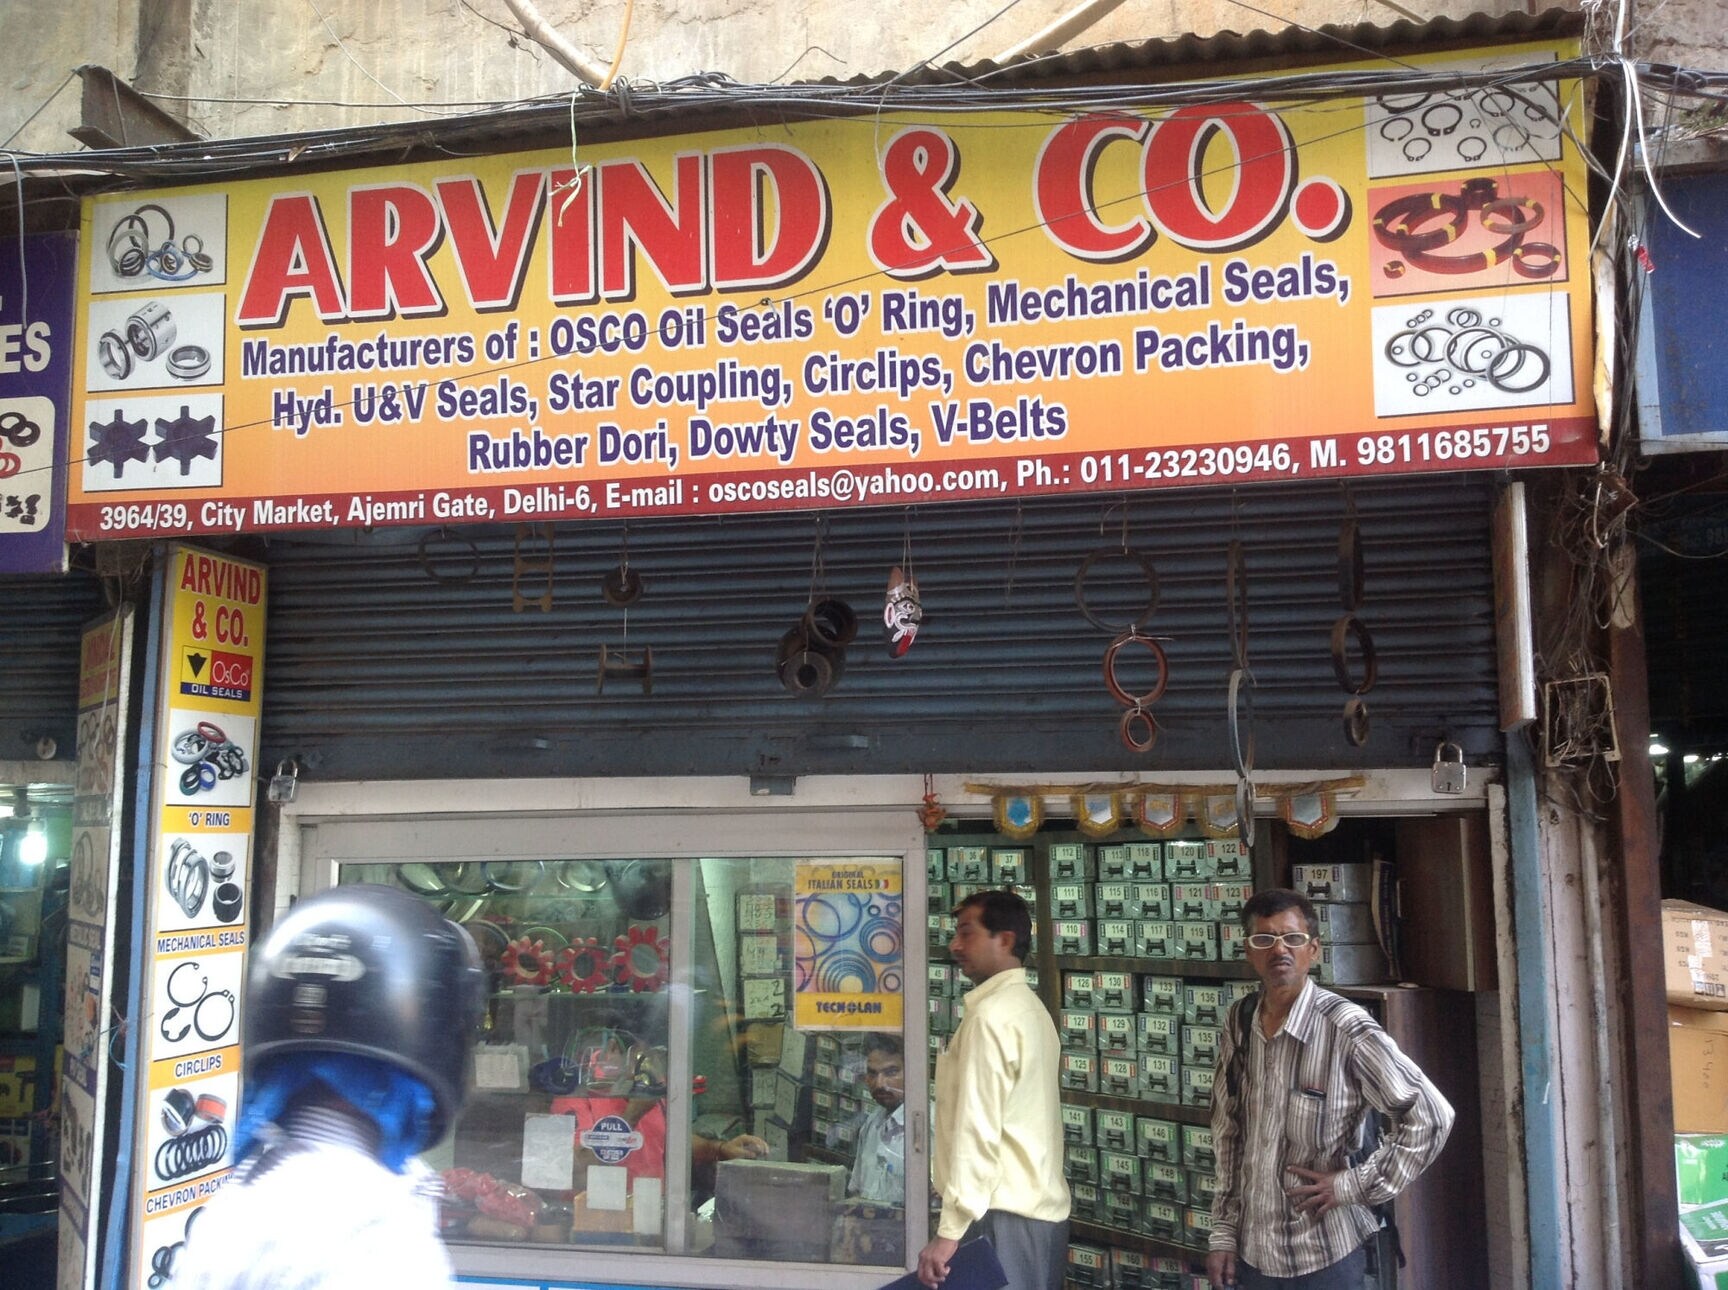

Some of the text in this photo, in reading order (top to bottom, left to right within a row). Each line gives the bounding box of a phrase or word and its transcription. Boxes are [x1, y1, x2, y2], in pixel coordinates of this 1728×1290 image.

[234, 100, 1350, 327] ARVIND & CO.
[243, 334, 474, 376] Manufacturers
[485, 322, 518, 361] of
[550, 313, 647, 357] OSCO
[659, 308, 705, 348] Oil
[717, 300, 813, 343] Seals
[883, 291, 974, 337] Ring,
[988, 265, 1209, 323] Mechanical
[1224, 255, 1349, 302] Seals,
[274, 322, 1308, 435] Hyd. U&V Seals, Star Coupling, Circlips, Chevron Packing,
[469, 399, 1066, 470] Rubber Dori, Dowty Seals, V-Belts
[99, 503, 194, 531] 3964/39,
[200, 501, 246, 532] City
[253, 491, 340, 526] Market,
[347, 488, 426, 523] Ajemri
[432, 484, 496, 520] Gate,
[504, 483, 598, 515] Delhi-6,
[606, 478, 683, 509] E-mail
[708, 466, 1008, 503] oscoseals@yahoo.com,
[1016, 451, 1070, 487] Ph.:
[1080, 445, 1300, 482] 011-23230946,
[1309, 438, 1347, 469] M.
[1356, 423, 1550, 466] 9811685755
[181, 553, 261, 605] ARVIND
[191, 600, 248, 647] & CO.
[191, 683, 243, 699] OIL SEALS
[205, 811, 230, 827] RING
[1222, 843, 1236, 853] 122
[1005, 855, 1013, 864] 37
[1311, 868, 1328, 880] 197
[807, 879, 873, 890] ITALIAN SEALS
[1188, 887, 1201, 897] 121
[1226, 887, 1240, 897] 123
[1066, 924, 1078, 934] 110
[1111, 924, 1124, 934] 114
[1151, 924, 1163, 934] 117
[1190, 926, 1204, 937] 119
[156, 929, 246, 953] MECHANICAL SEALS
[1109, 976, 1122, 986] 130
[1159, 981, 1173, 992] 133
[1073, 1016, 1086, 1026] 127
[1112, 1018, 1126, 1029] 129
[1152, 1020, 1167, 1031] 132
[1198, 1032, 1213, 1043] 135
[174, 1054, 222, 1078] CIRCLIPS
[1074, 1059, 1087, 1069] 125
[1152, 1059, 1167, 1070] 131
[1069, 1111, 1081, 1121] 141
[1110, 1116, 1123, 1127] 143
[600, 1122, 623, 1132] PULL
[1152, 1126, 1166, 1138] 146
[1116, 1159, 1129, 1171] 145
[146, 1185, 197, 1214] CHEVRON
[1157, 1207, 1172, 1218] 147
[1079, 1253, 1093, 1264] 155
